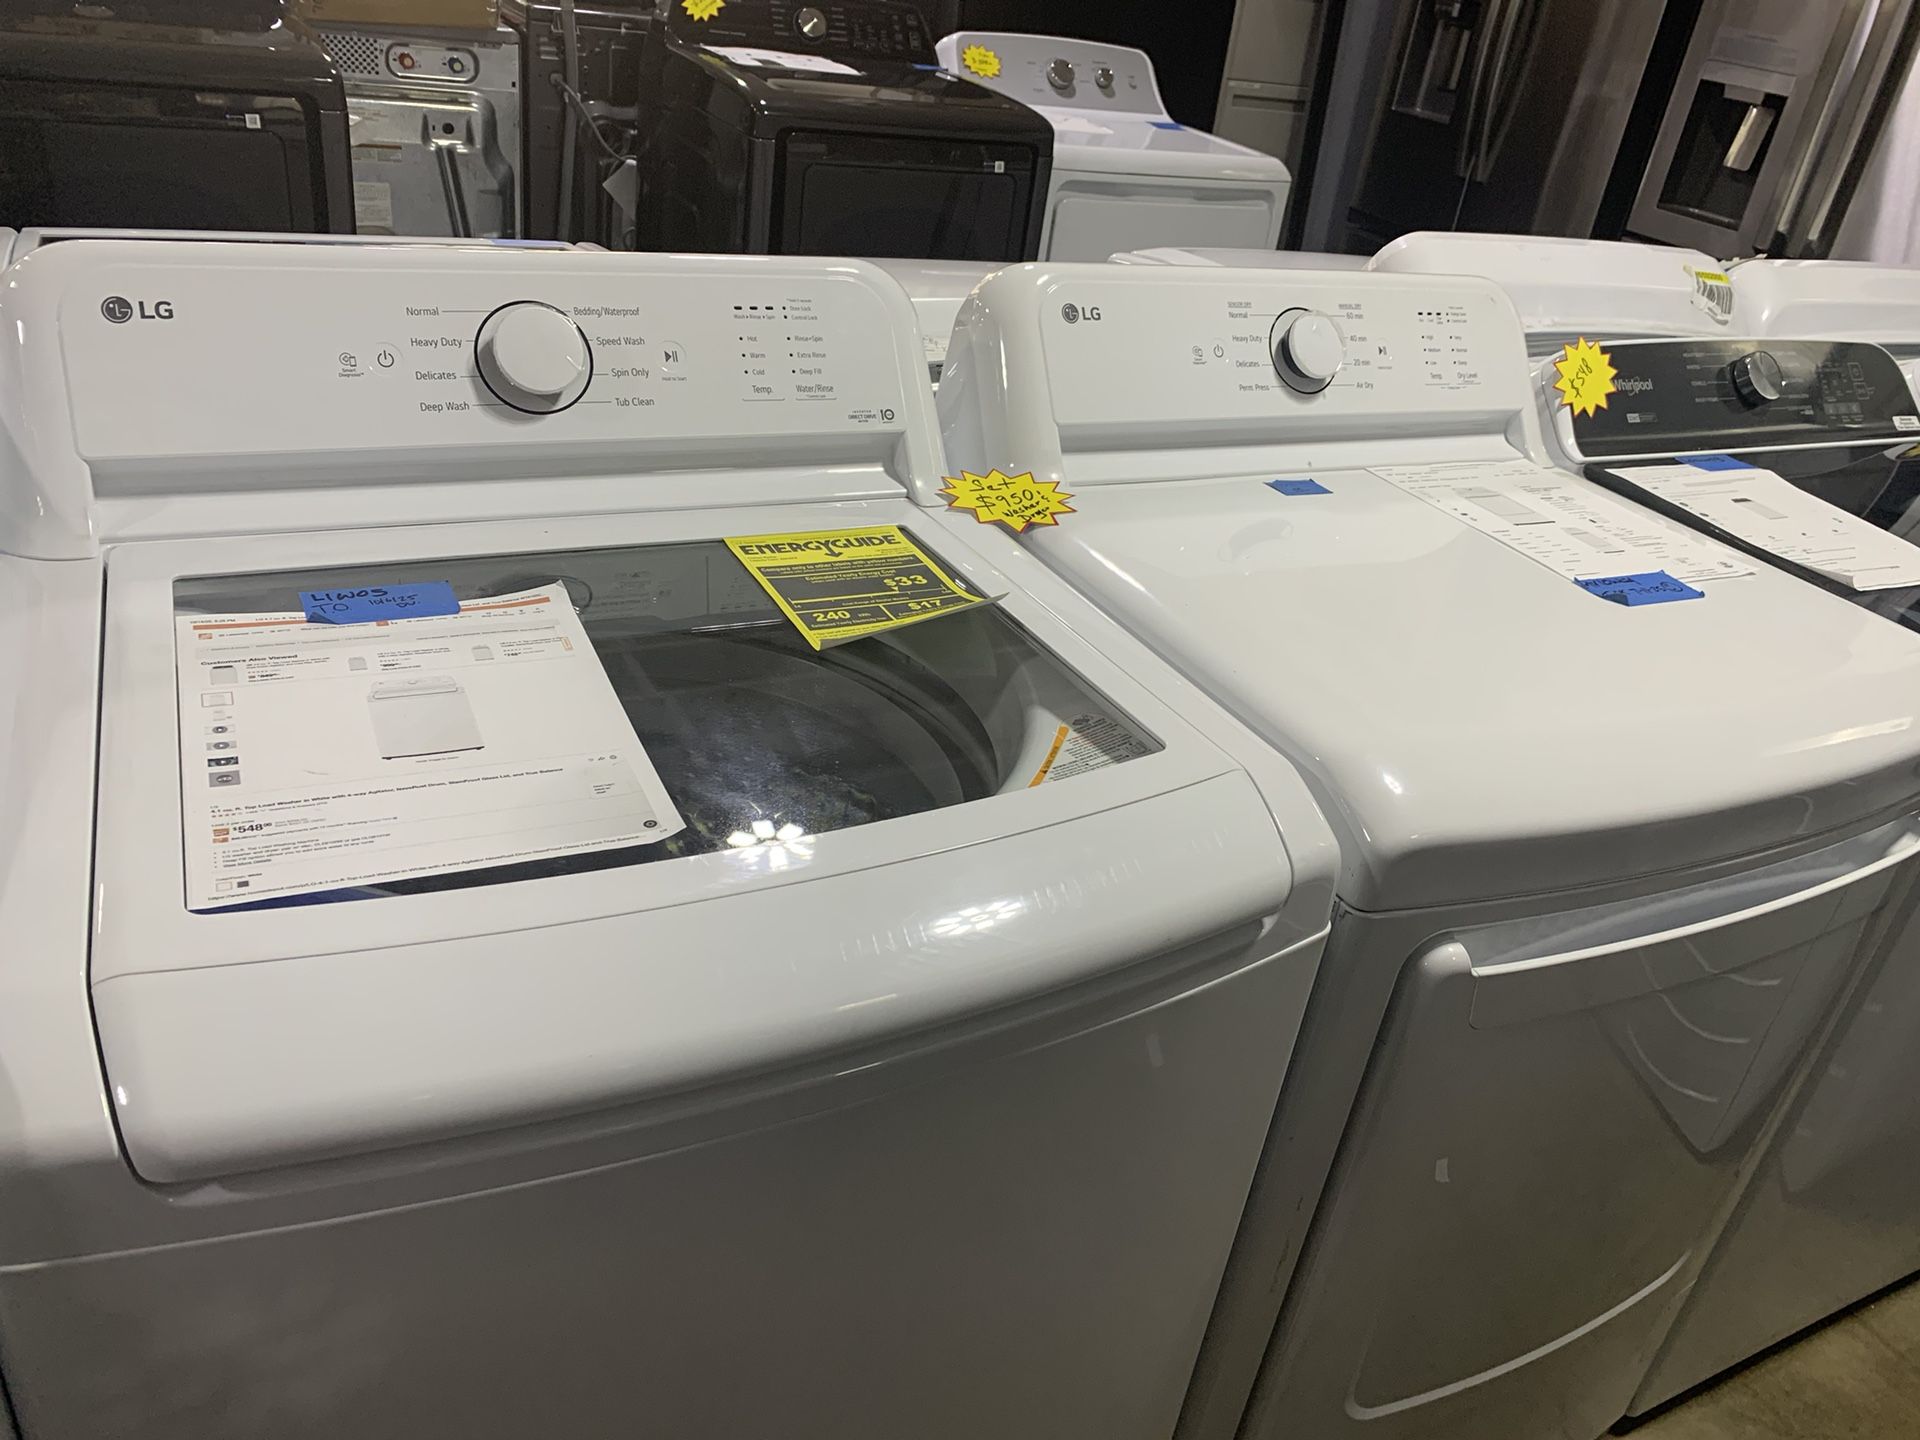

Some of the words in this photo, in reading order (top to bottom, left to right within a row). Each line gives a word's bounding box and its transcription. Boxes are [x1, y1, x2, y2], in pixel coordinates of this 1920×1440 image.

[138, 300, 174, 320] LG
[405, 306, 440, 316] Normal
[573, 306, 640, 318] Bedding/Waterproof
[1081, 306, 1102, 321] LG
[1228, 311, 1248, 319] Normal
[410, 337, 438, 349] Heavy
[440, 336, 463, 348] Duty
[596, 336, 622, 348] Speed
[623, 336, 646, 346] Wash
[1232, 335, 1248, 343] Heavy
[1249, 334, 1262, 343] Duty
[1235, 360, 1260, 368] Delicates
[415, 370, 457, 381] Delicates
[611, 367, 630, 379] Spin
[631, 367, 650, 379] Only
[751, 368, 765, 376] Cold
[795, 384, 834, 393] Water/Rinse
[1255, 383, 1270, 391] Press
[615, 397, 630, 407] Tub
[631, 396, 655, 407] Clean
[419, 402, 444, 414] Deep
[445, 401, 470, 411] Wash
[969, 478, 1016, 491] Set
[738, 534, 902, 556] ENERGYGUIDE
[883, 574, 928, 587] $33
[907, 599, 941, 610] $17
[812, 610, 850, 622] 240
[201, 658, 246, 666] Customers
